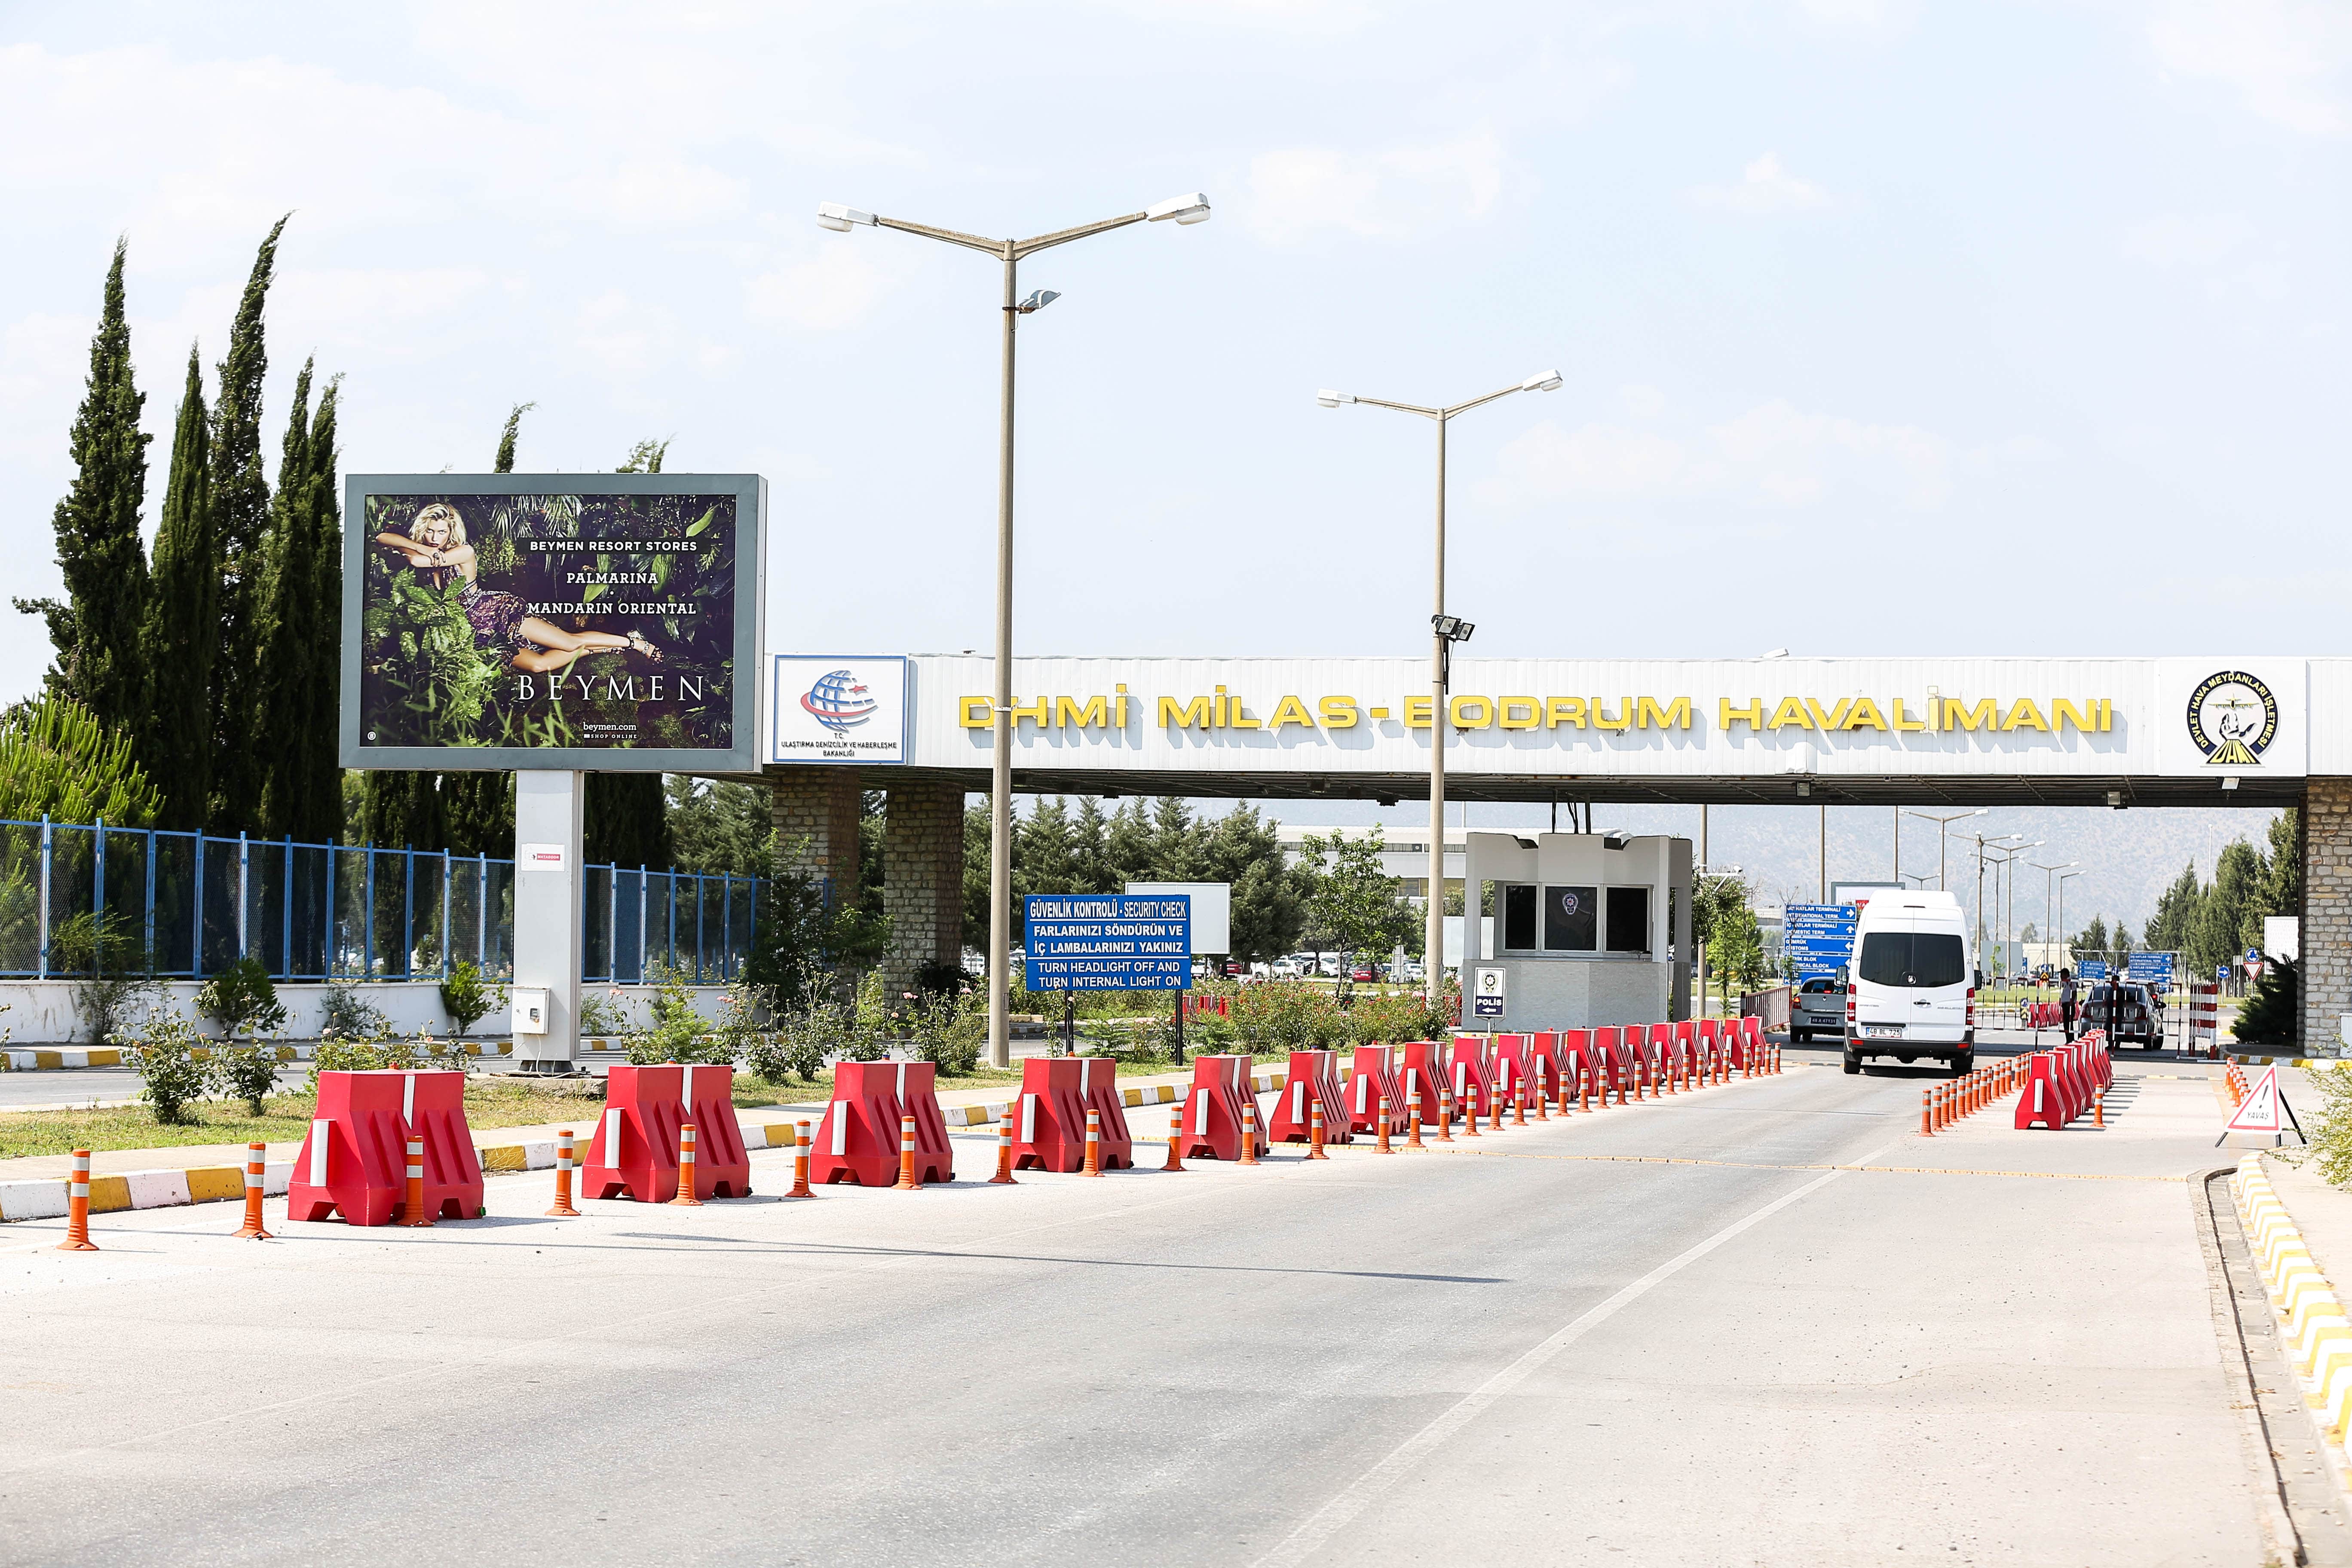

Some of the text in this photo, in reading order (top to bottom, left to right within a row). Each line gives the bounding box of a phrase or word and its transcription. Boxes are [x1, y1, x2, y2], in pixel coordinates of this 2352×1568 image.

[530, 541, 697, 551] BEYMEN RESORT STORES
[566, 572, 658, 584] PALMARINA
[527, 603, 697, 615] MANDARIN ORIENTAL
[518, 675, 704, 701] BEYMEN
[2208, 673, 2268, 697] MEYDANLARI
[2190, 686, 2210, 710] HAVA
[959, 683, 1127, 729] DHMİ
[1719, 686, 2111, 732] HAVALİMANI
[583, 721, 637, 732] beymen.com
[2190, 711, 2208, 748] DEVLET
[781, 741, 814, 750] ULAŞTIRMA
[858, 741, 897, 750] HABERLEŞME
[823, 749, 855, 757] BAKANLIĞI
[1030, 898, 1072, 918] GÜVENLİK
[1074, 898, 1118, 918] KONTROLÜ
[1124, 901, 1160, 917] SECURITY
[1161, 901, 1186, 917] CHECK
[1034, 923, 1183, 937] FARLARINIZI SÖNDÜRÜN VE
[1034, 940, 1183, 956] İÇ LAMBALARINIZI YAKINIZ
[1038, 962, 1180, 973] TURN HEADLIGHT OFF AND
[1038, 976, 1181, 987] TURN INTERNAL LIGHT ON
[1476, 998, 1502, 1006] POLİS
[2247, 1112, 2269, 1120] YAVAŞ
